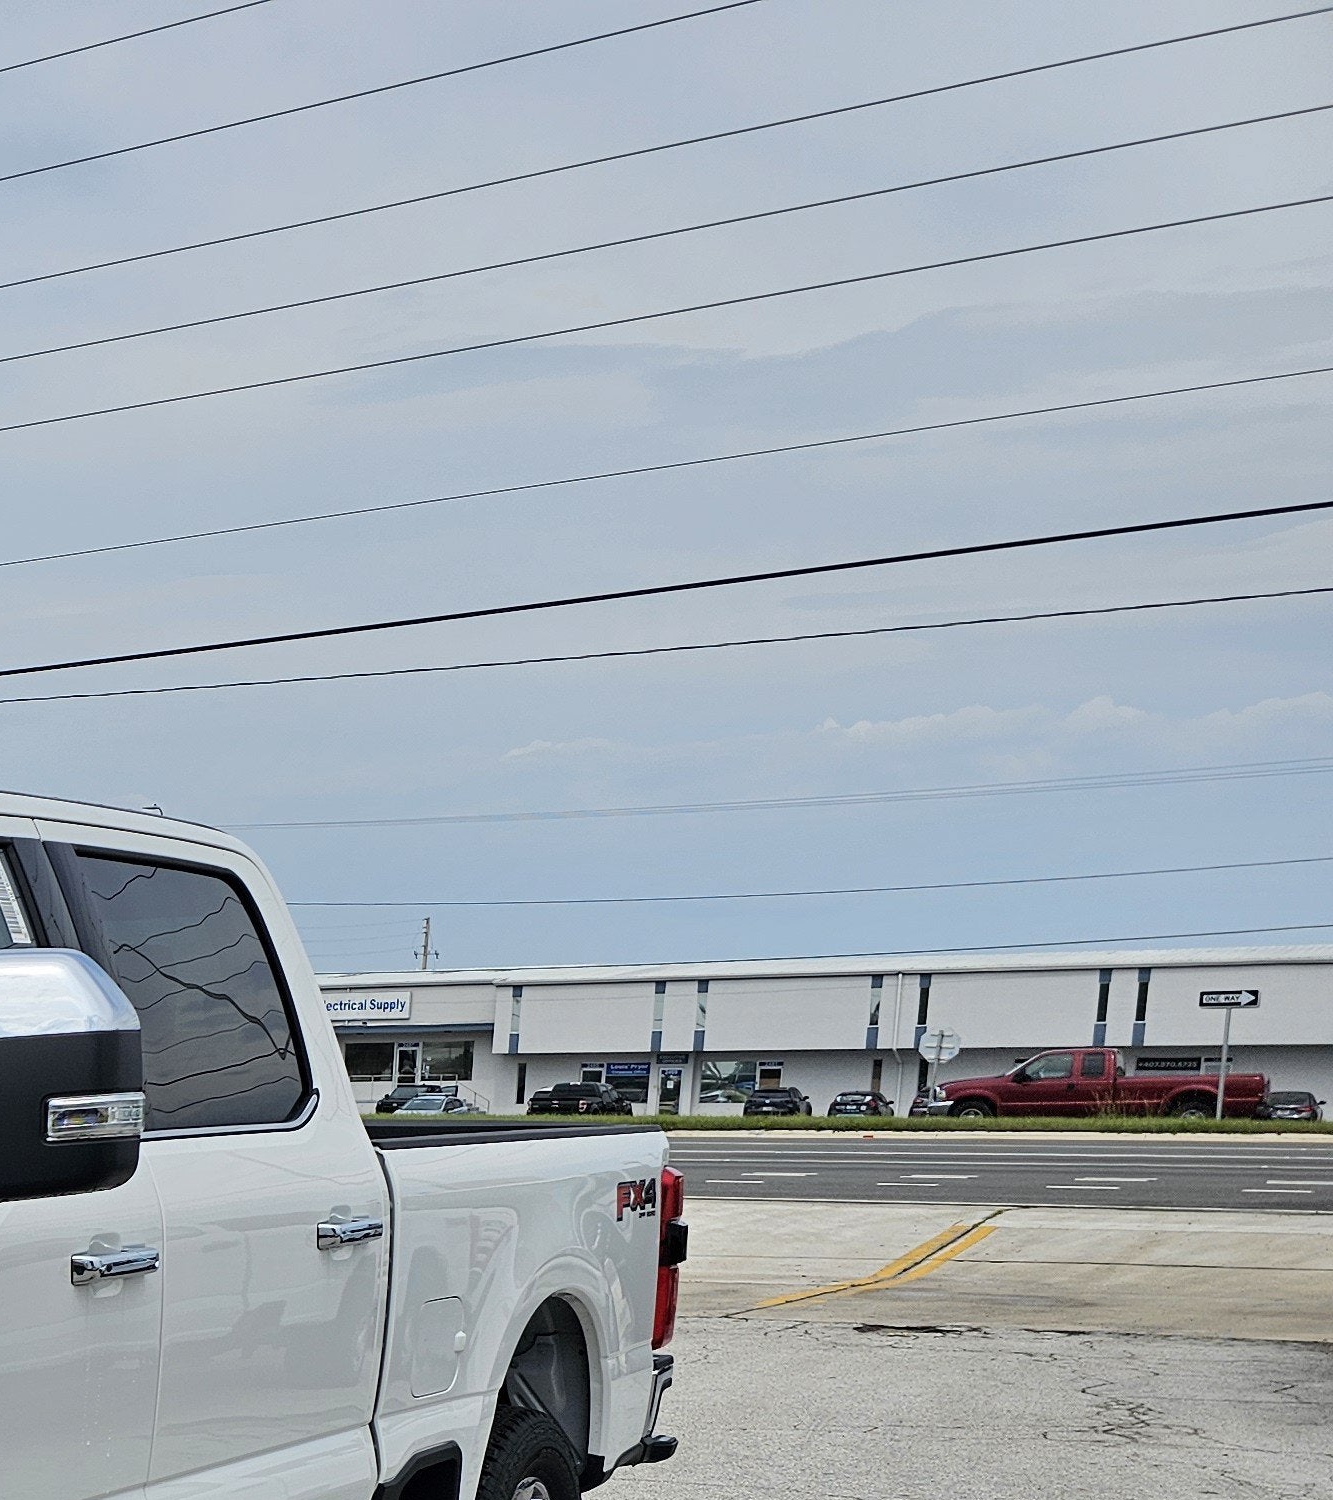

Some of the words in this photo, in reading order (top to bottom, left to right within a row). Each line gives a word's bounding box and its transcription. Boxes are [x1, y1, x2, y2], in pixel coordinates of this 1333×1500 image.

[324, 999, 367, 1012] ectrical
[369, 998, 406, 1012] Supply
[616, 1178, 657, 1222] FX4
